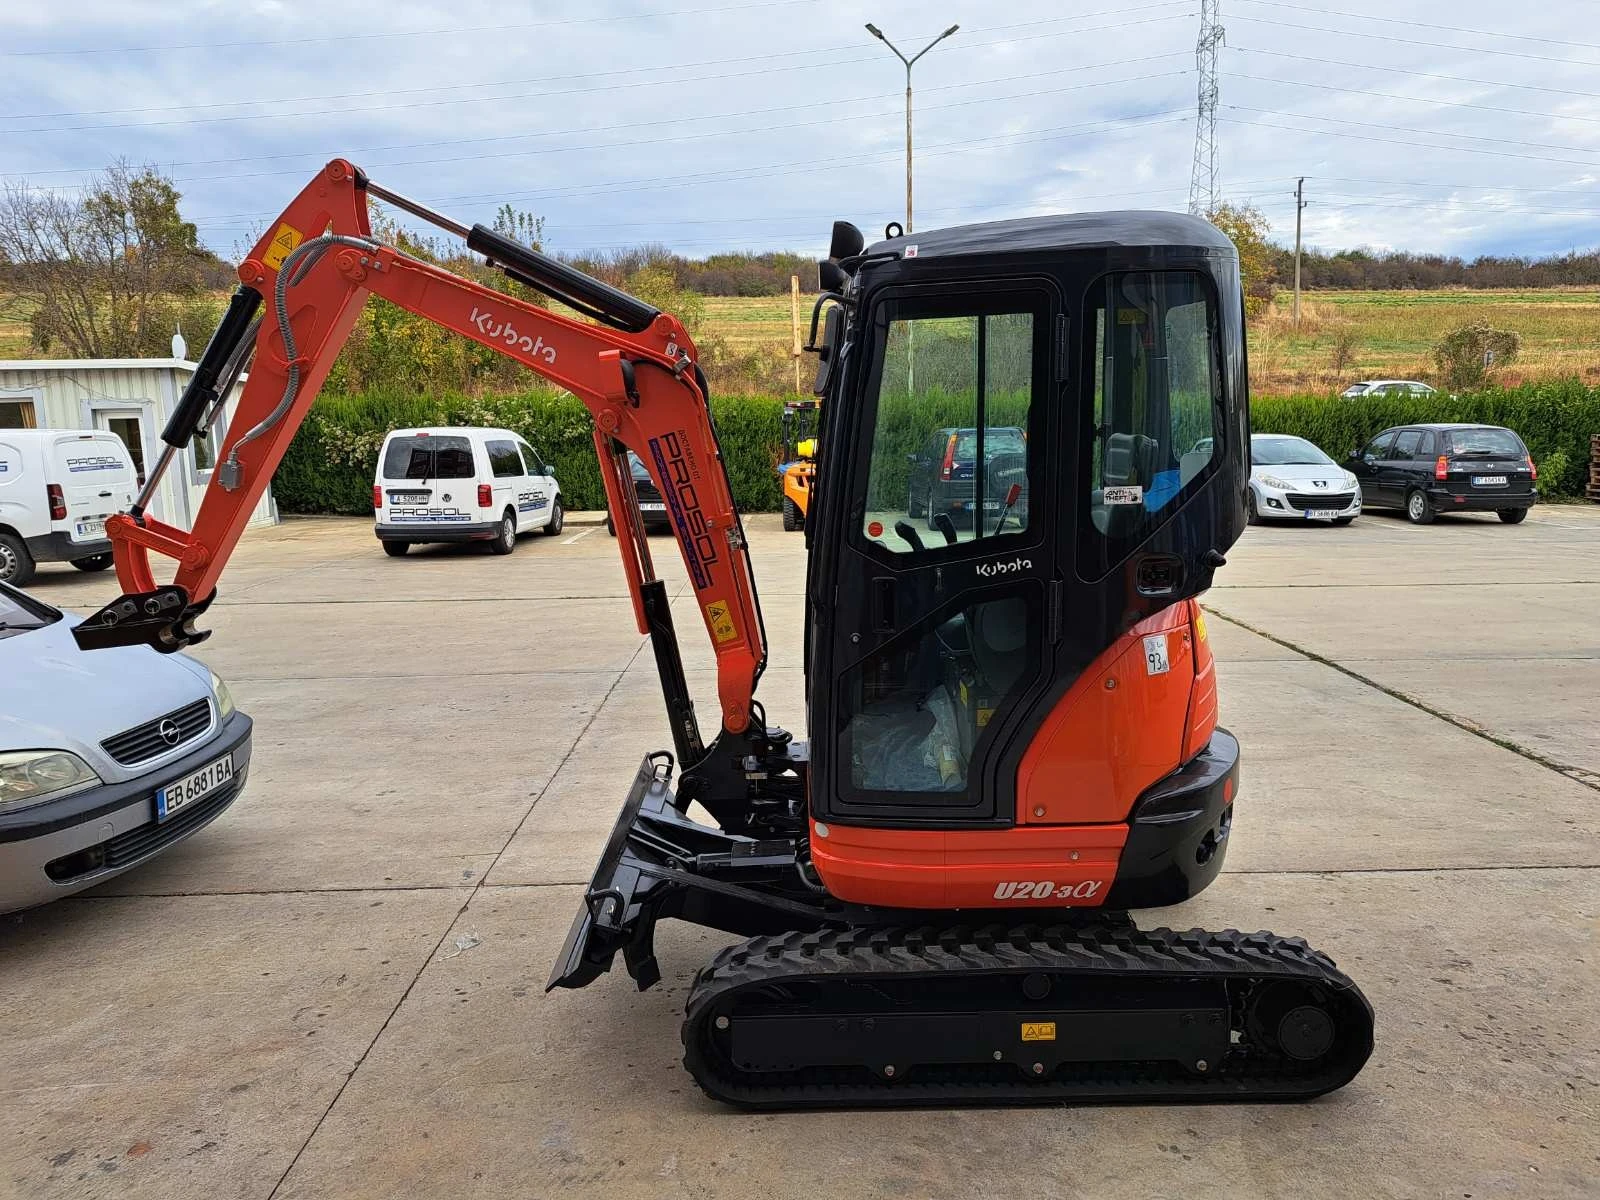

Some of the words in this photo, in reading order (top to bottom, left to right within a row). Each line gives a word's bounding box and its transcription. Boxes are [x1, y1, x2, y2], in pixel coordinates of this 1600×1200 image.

[469, 307, 556, 364] Kubota
[390, 508, 471, 516] PROSOL
[660, 431, 718, 587] PROSOL
[976, 558, 1032, 577] Kubota
[1149, 653, 1162, 672] 93
[167, 785, 184, 811] EB
[186, 767, 214, 799] 6881
[216, 759, 231, 783] BA
